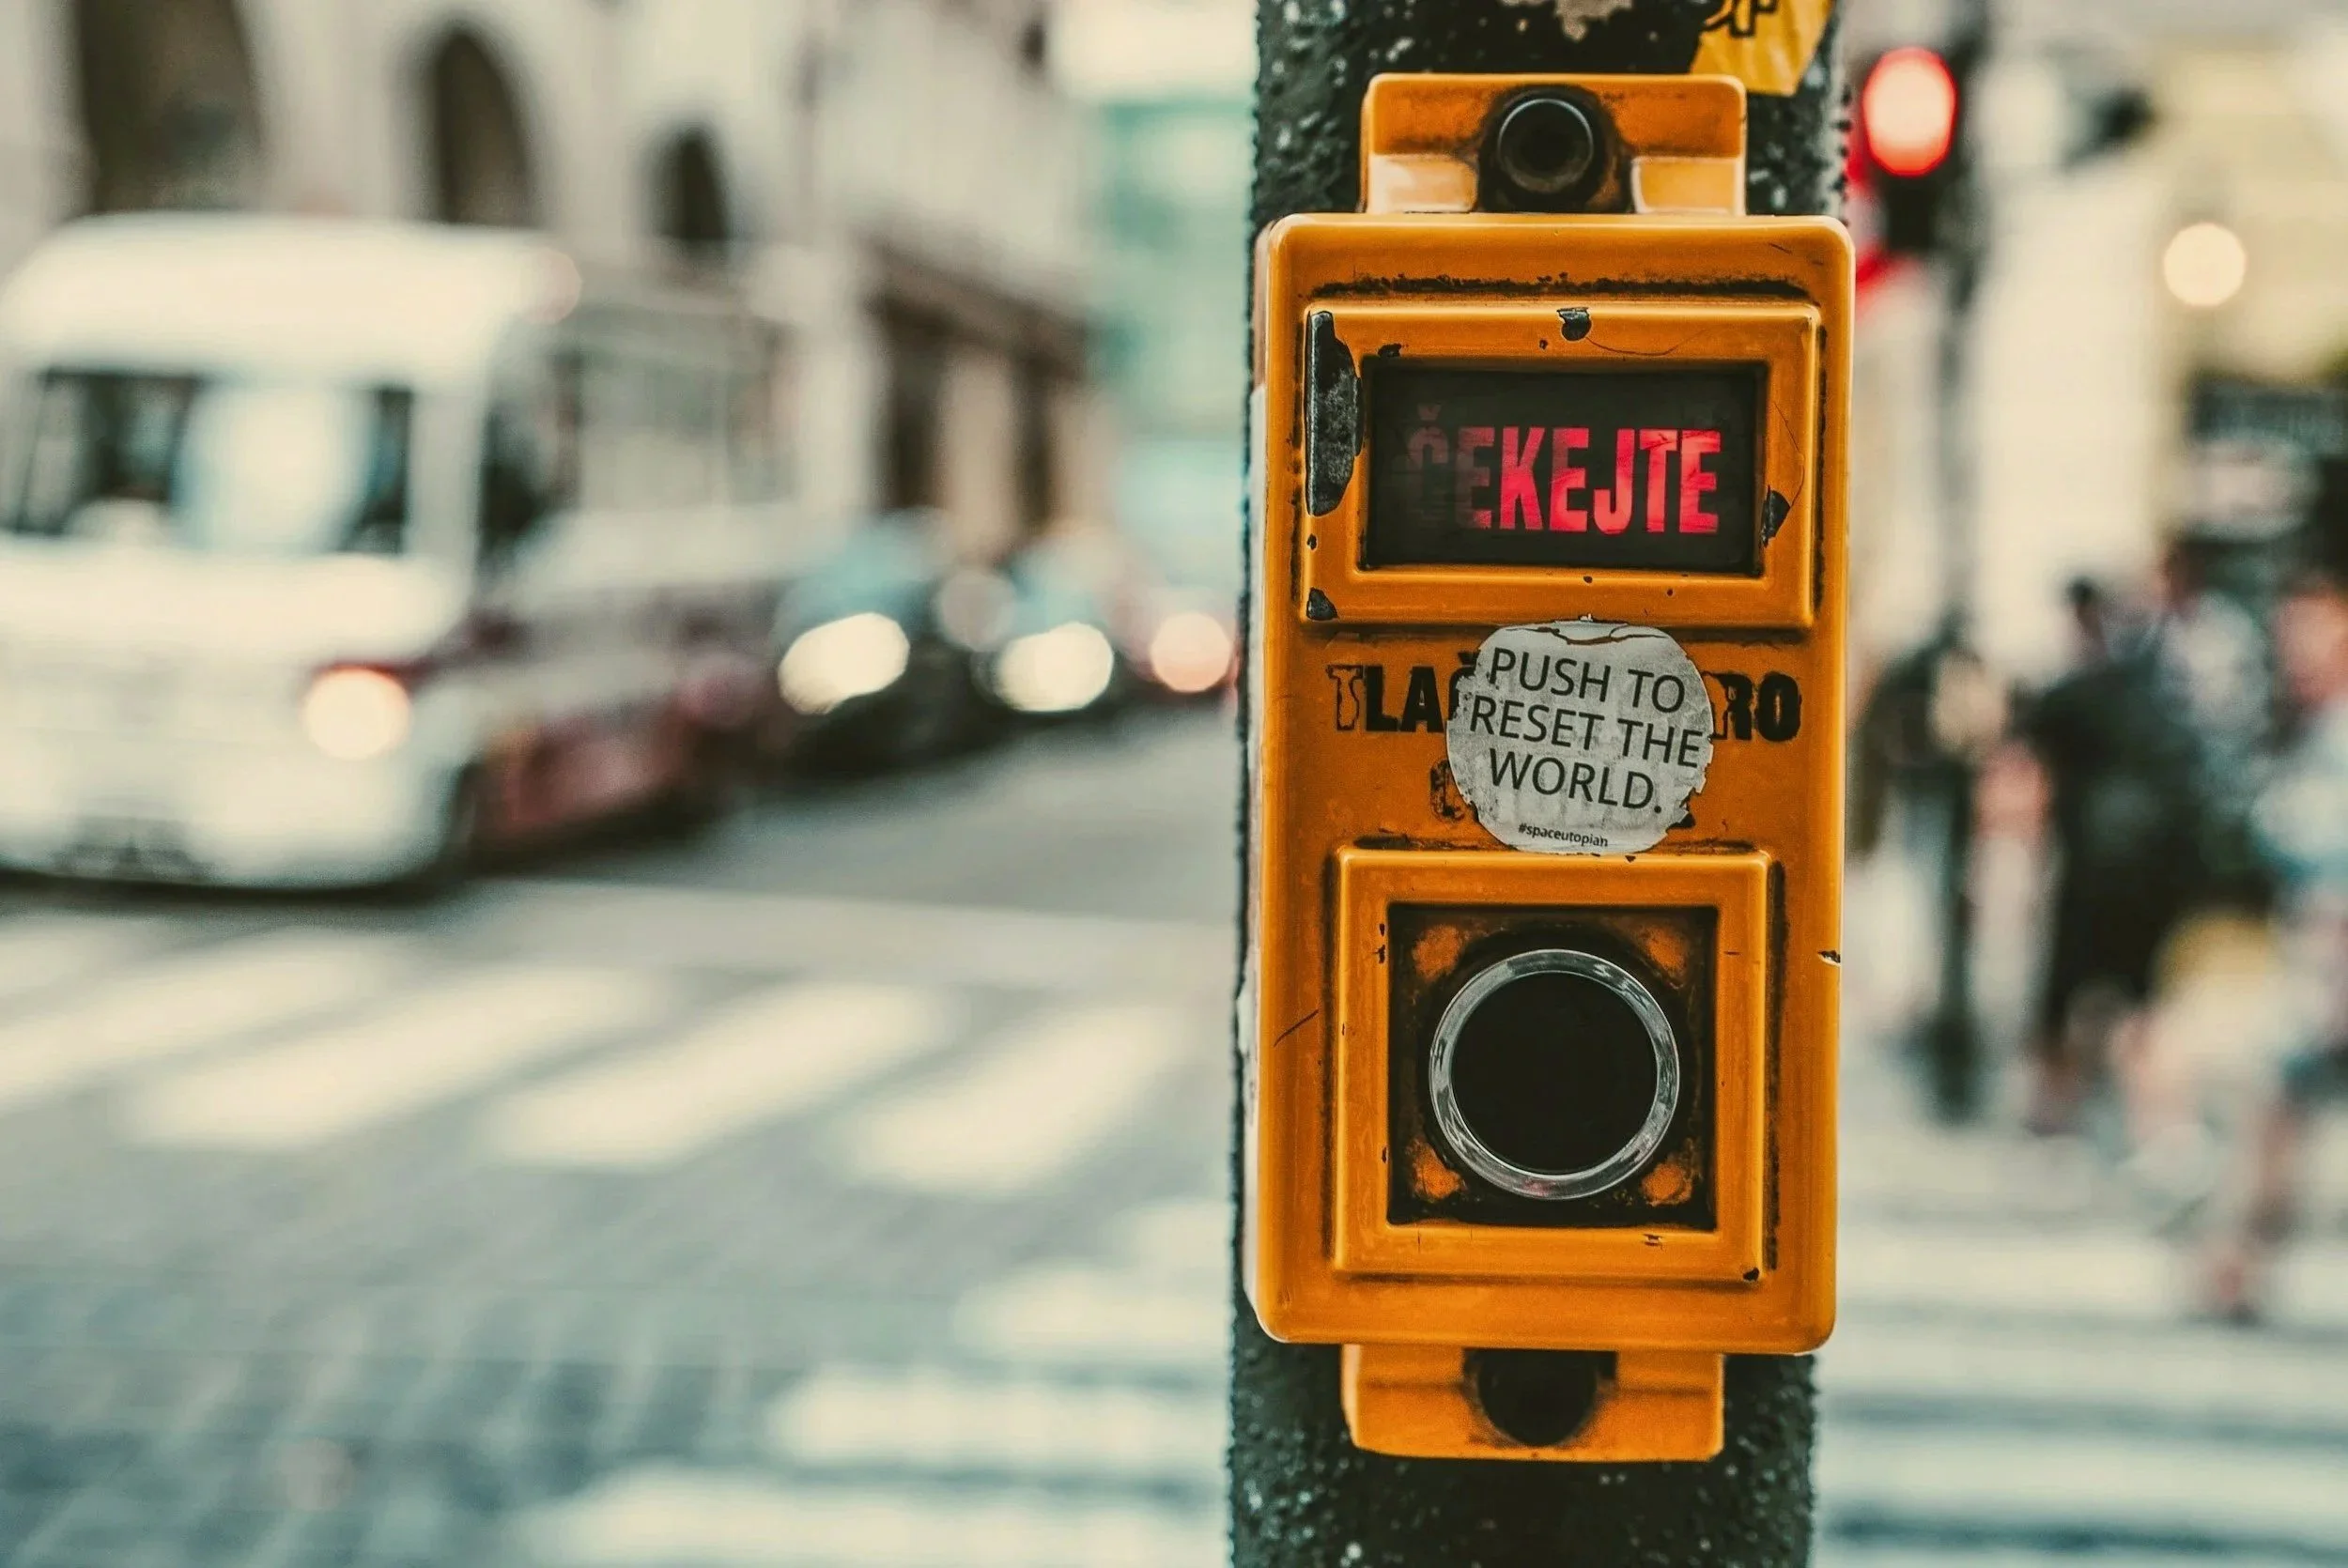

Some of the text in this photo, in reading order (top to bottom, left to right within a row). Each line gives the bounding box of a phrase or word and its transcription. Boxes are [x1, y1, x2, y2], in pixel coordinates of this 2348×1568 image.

[1487, 646, 1686, 715] PUSH TO
[1702, 669, 1802, 742] RO
[1469, 694, 1704, 769] RESET THE
[1489, 747, 1662, 815] WORLD.
[1518, 822, 1609, 847] #spaceutopian
